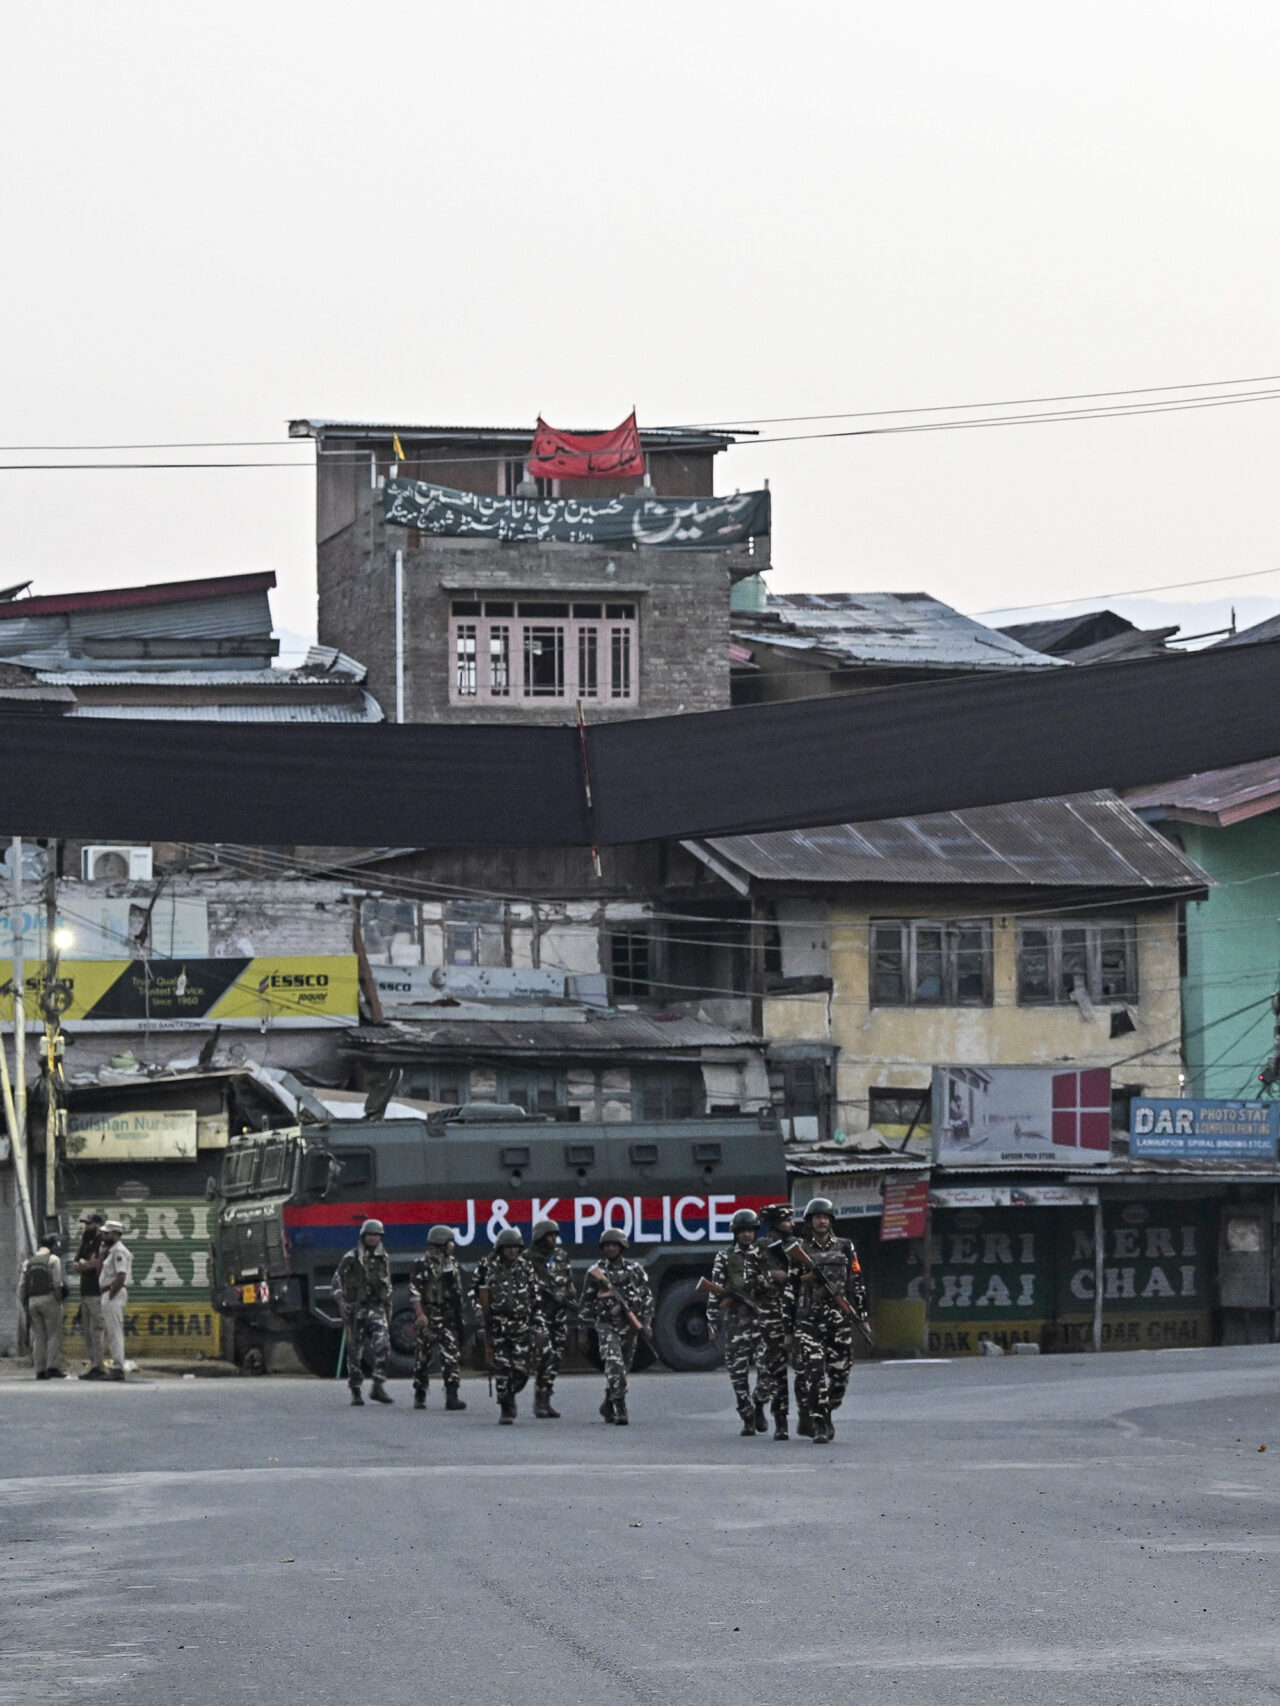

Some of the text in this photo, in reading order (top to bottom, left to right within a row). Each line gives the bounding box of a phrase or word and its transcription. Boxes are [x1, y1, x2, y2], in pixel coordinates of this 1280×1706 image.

[536, 439, 575, 465] سین
[270, 974, 329, 988] ESSCO
[377, 982, 412, 992] SSCO
[67, 1116, 130, 1132] Gulshan
[1134, 1107, 1194, 1135] DAR
[1200, 1108, 1269, 1121] PHOTO STAT
[1136, 1138, 1184, 1147] LAMINATION
[1187, 1139, 1215, 1148] SPIRAL
[453, 1194, 736, 1247] J & K POLICE
[906, 1233, 1036, 1265] MERI
[1071, 1226, 1198, 1260] MERI
[906, 1273, 1037, 1307] CHAI
[1070, 1265, 1198, 1300] CHAI
[148, 1314, 213, 1337] CHAI
